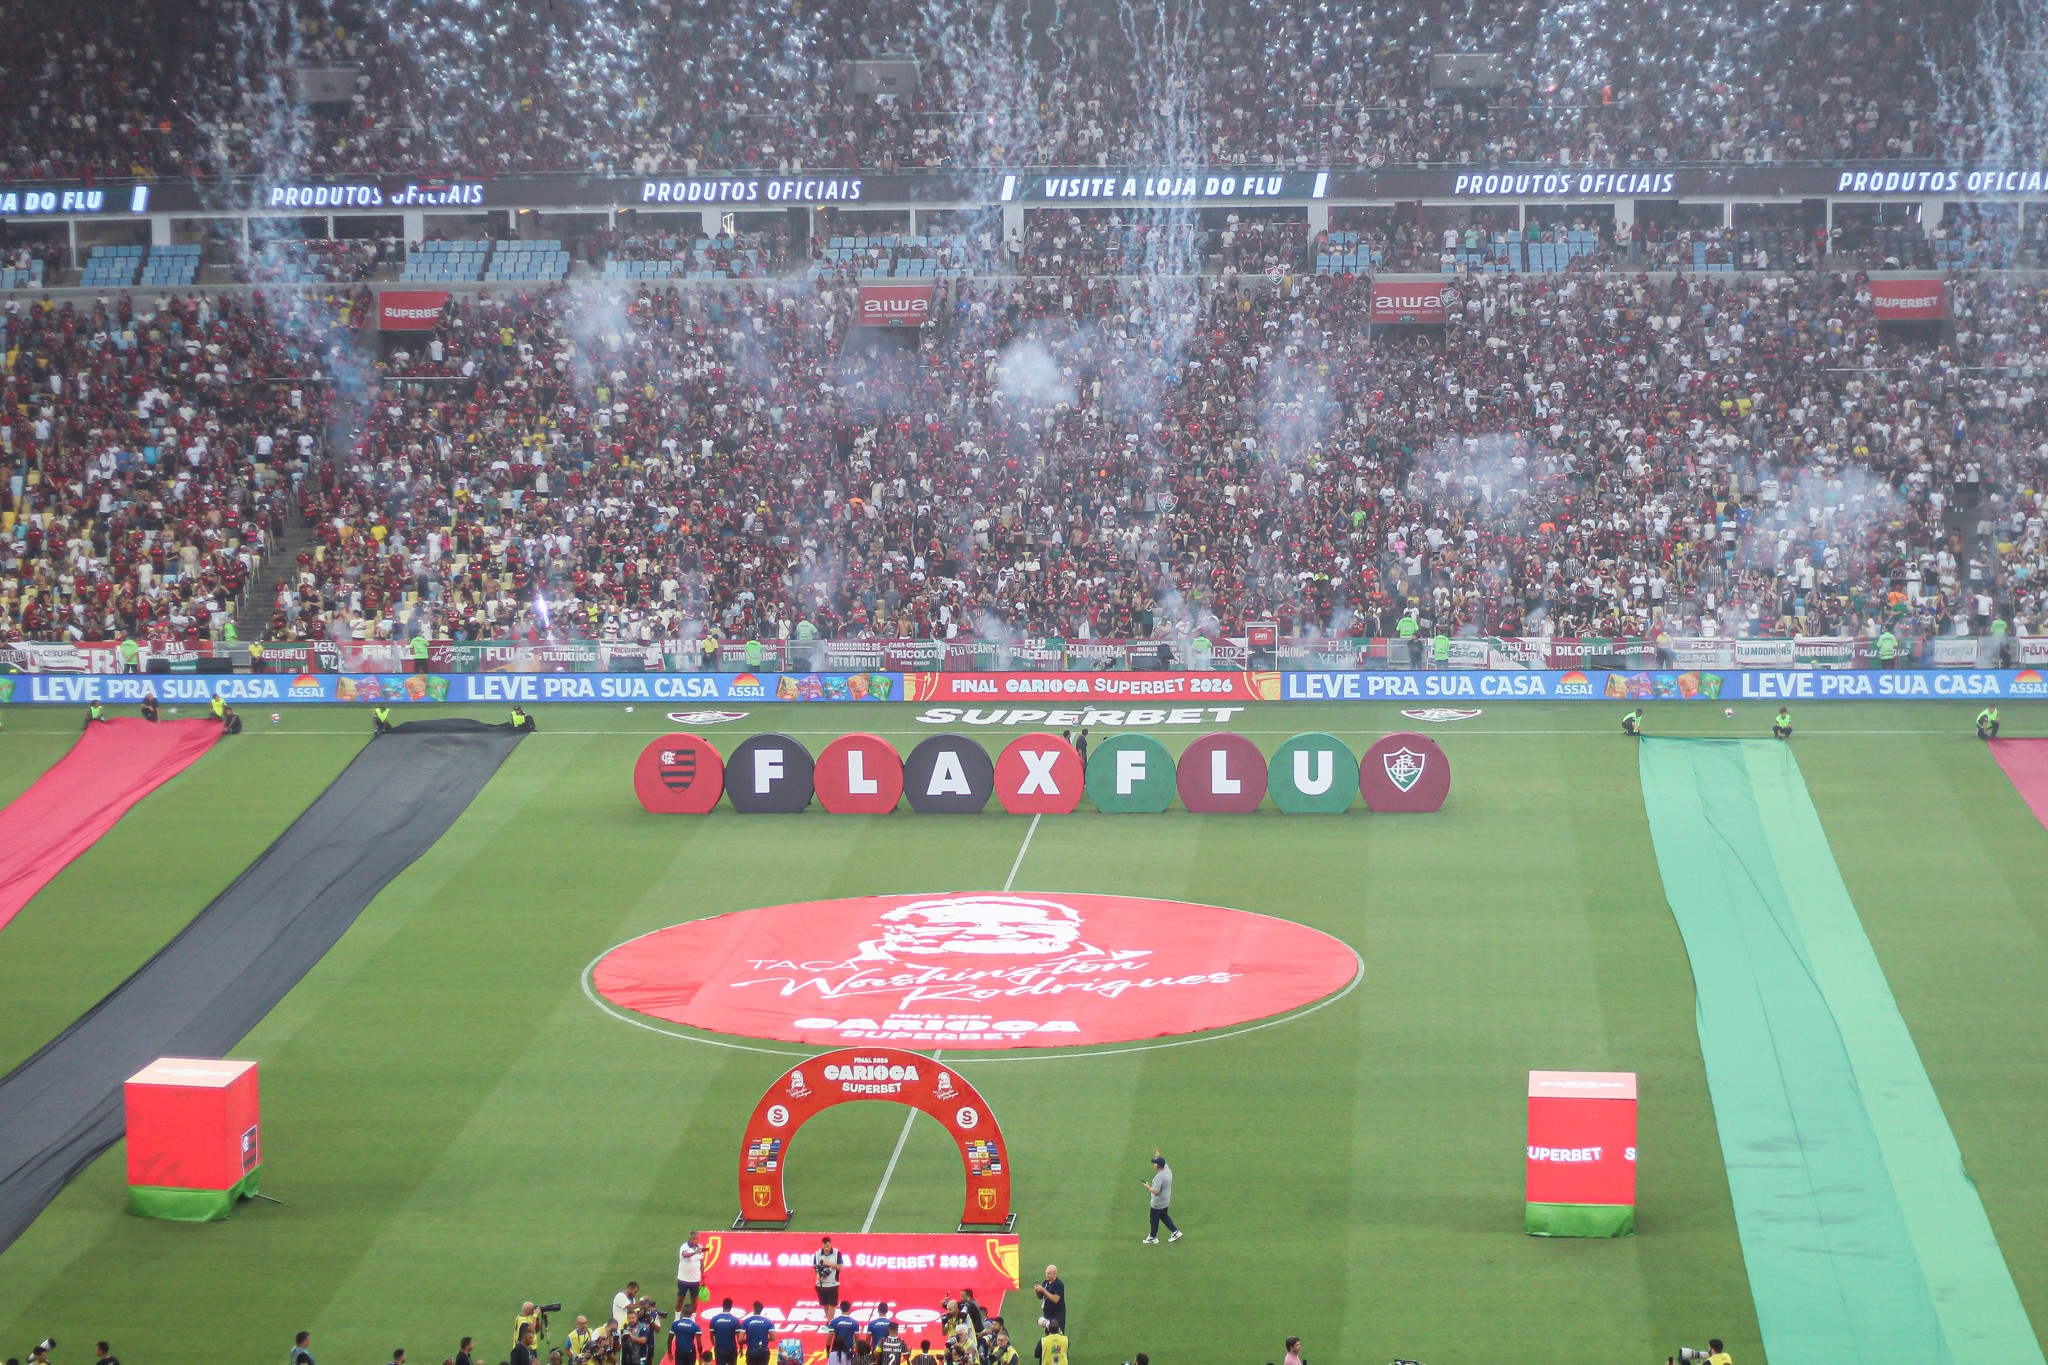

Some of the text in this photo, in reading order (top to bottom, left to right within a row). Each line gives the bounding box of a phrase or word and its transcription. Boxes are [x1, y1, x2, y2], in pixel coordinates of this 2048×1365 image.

[642, 180, 862, 201] PRODUTOS OFICIAIS
[1045, 176, 1283, 197] VISITE A LOJA DO FLU
[1455, 173, 1674, 194] PRODUTOS OFICIAIS
[1838, 172, 1959, 191] PRODUTOS
[24, 192, 56, 211] DO
[62, 191, 102, 210] FLU
[864, 299, 928, 311] aiwa
[1375, 296, 1441, 308] aiwa
[1875, 296, 1938, 308] SUPERBET
[1024, 639, 1046, 649] FLU
[32, 677, 279, 700] LEVE PRA SUA CASA
[468, 676, 719, 699] LEVE PRA SUA CASA
[952, 677, 1233, 694] FINAL CARIOCA SUPERBET 2026
[1289, 674, 1546, 698] LEVE PRA SUA CASA
[1742, 673, 2000, 697] LEVE PRA SUA CASA
[915, 707, 1244, 726] SUPERBET
[754, 750, 1333, 795] F L A X F L U
[747, 960, 860, 972] TAÇA
[730, 957, 1149, 996] Washington
[821, 972, 1243, 1010] Rodrigues
[793, 1018, 1081, 1033] CARIOCA
[839, 1030, 1026, 1040] SUPERBET
[824, 1065, 919, 1080] CARIOCA
[842, 1082, 902, 1093] SUPERBET
[1527, 1146, 1602, 1162] UPERBET
[729, 1253, 772, 1266] FINAL
[855, 1253, 936, 1269] SUPERBET
[939, 1254, 978, 1268] 2026
[701, 1307, 944, 1323] CARIOC
